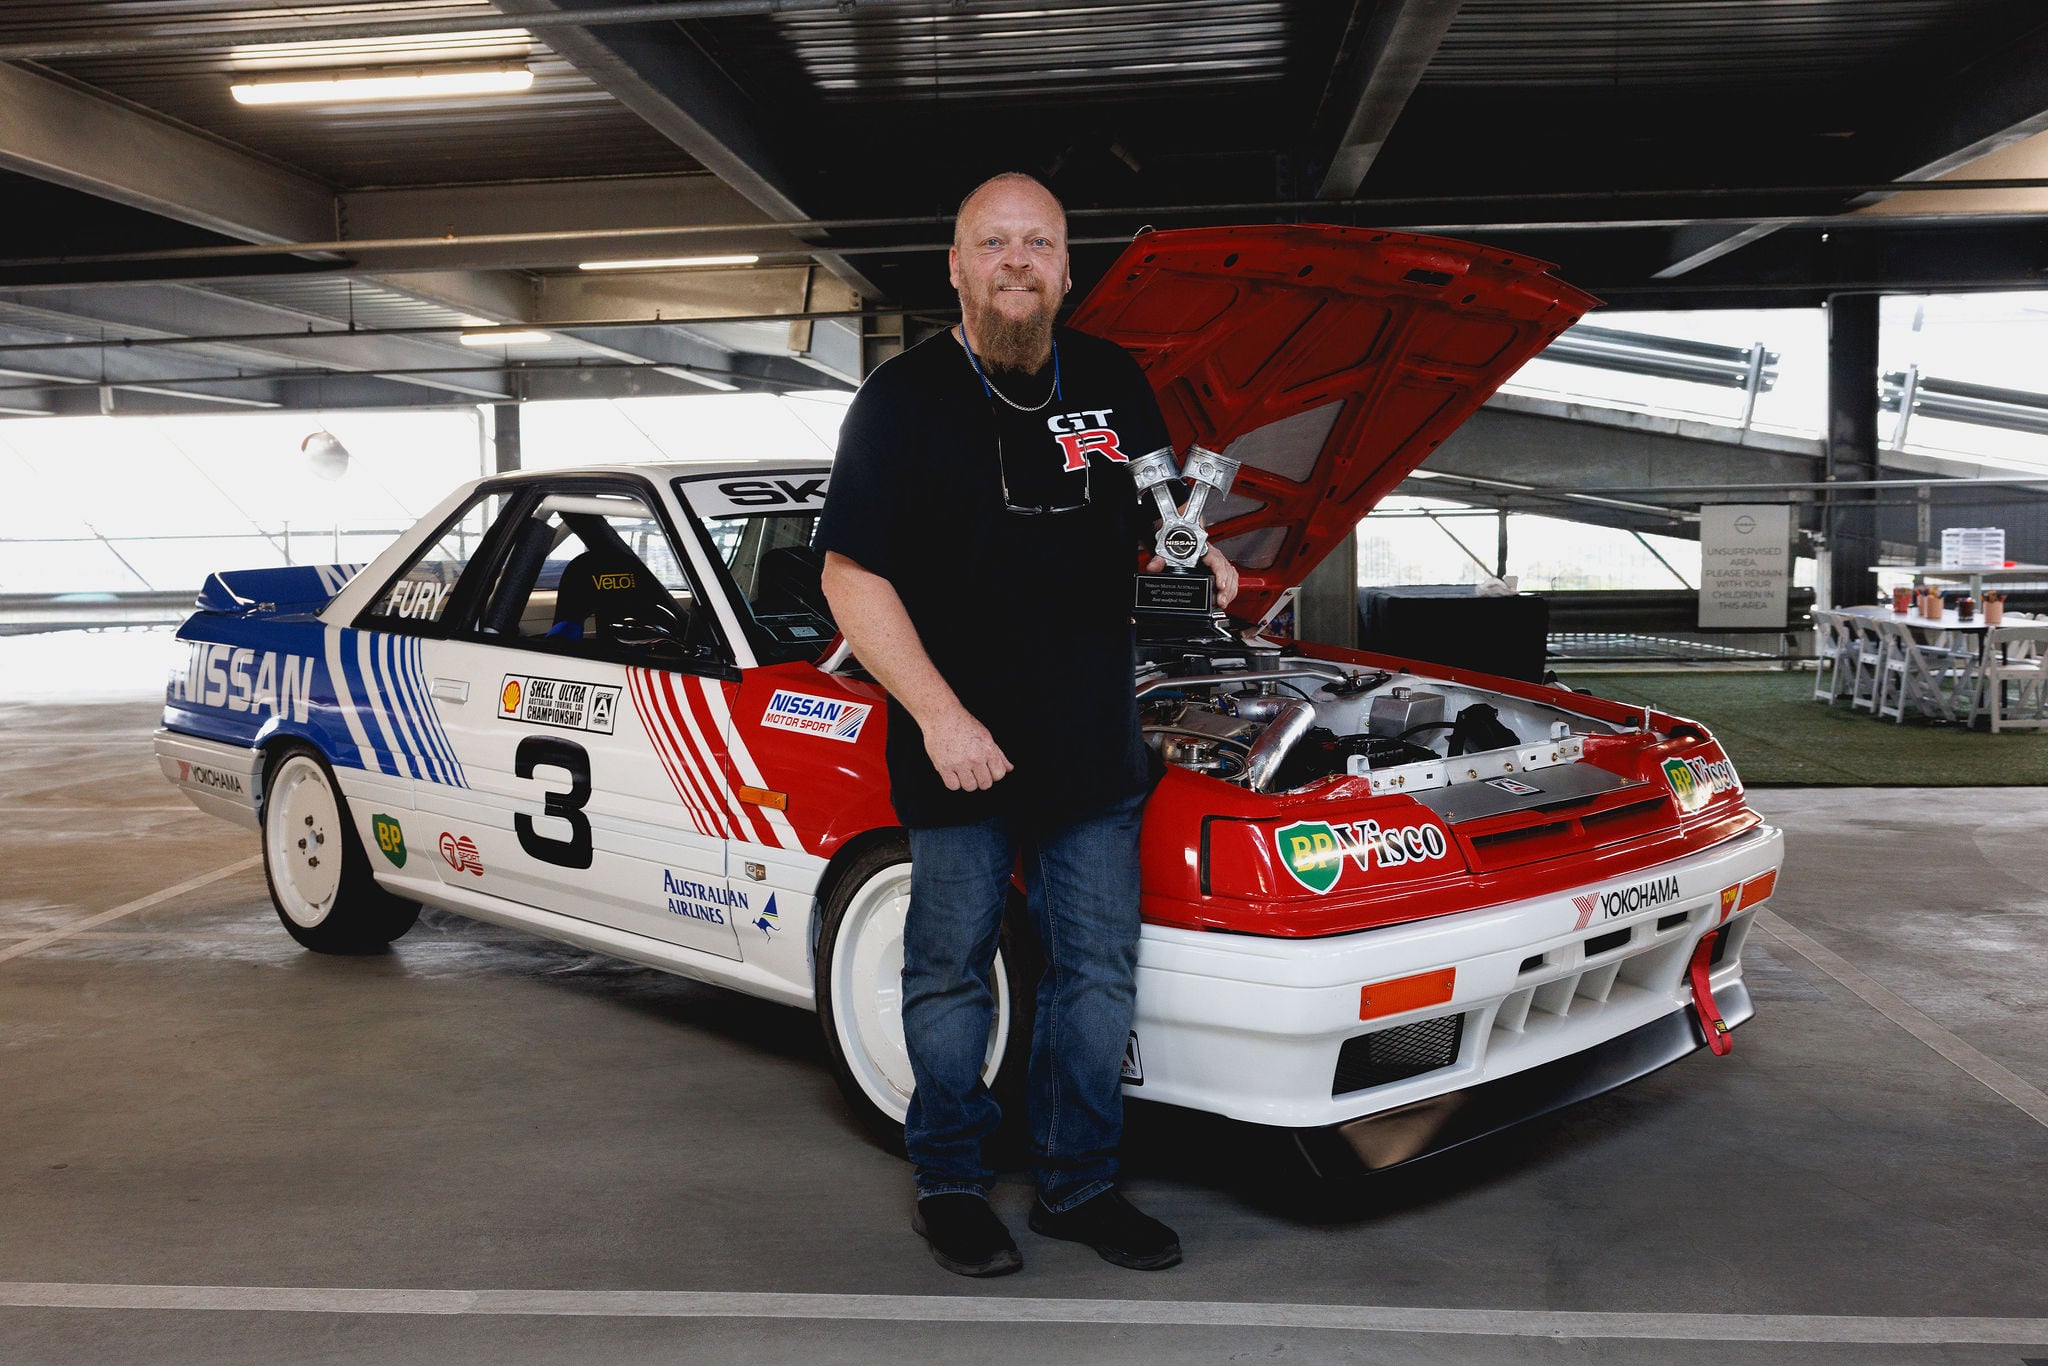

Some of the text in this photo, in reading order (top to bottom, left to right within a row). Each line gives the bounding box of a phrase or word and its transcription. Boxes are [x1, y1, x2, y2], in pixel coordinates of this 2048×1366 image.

[1047, 409, 1113, 433] GT
[1707, 547, 1781, 555] UNSUPERVISED
[1705, 569, 1782, 577] PLEASE REMAIN
[1716, 580, 1771, 588] WITH YOUR
[385, 580, 451, 621] FURY
[1712, 590, 1775, 599] CHILDREN IN
[1719, 601, 1768, 610] THIS AREA
[173, 642, 314, 724] NISSAN
[530, 680, 587, 703] SHELL ULTRA
[527, 705, 582, 726] CHAMPIONSHIP
[528, 697, 584, 711] AUSTRALIAN TOURING CAR
[770, 693, 842, 720] NISSAN
[765, 713, 833, 733] MOTOR SPORT
[190, 764, 244, 793] YOKOHAMA
[1670, 766, 1694, 796] BP
[514, 734, 594, 870] 3
[377, 822, 401, 853] BP
[1289, 821, 1446, 873] BP Visco
[664, 869, 749, 910] AUSTRALIAN
[1600, 875, 1680, 920] YOKOHAMA
[1722, 888, 1738, 905] TOW
[668, 898, 725, 925] AIRLINES
